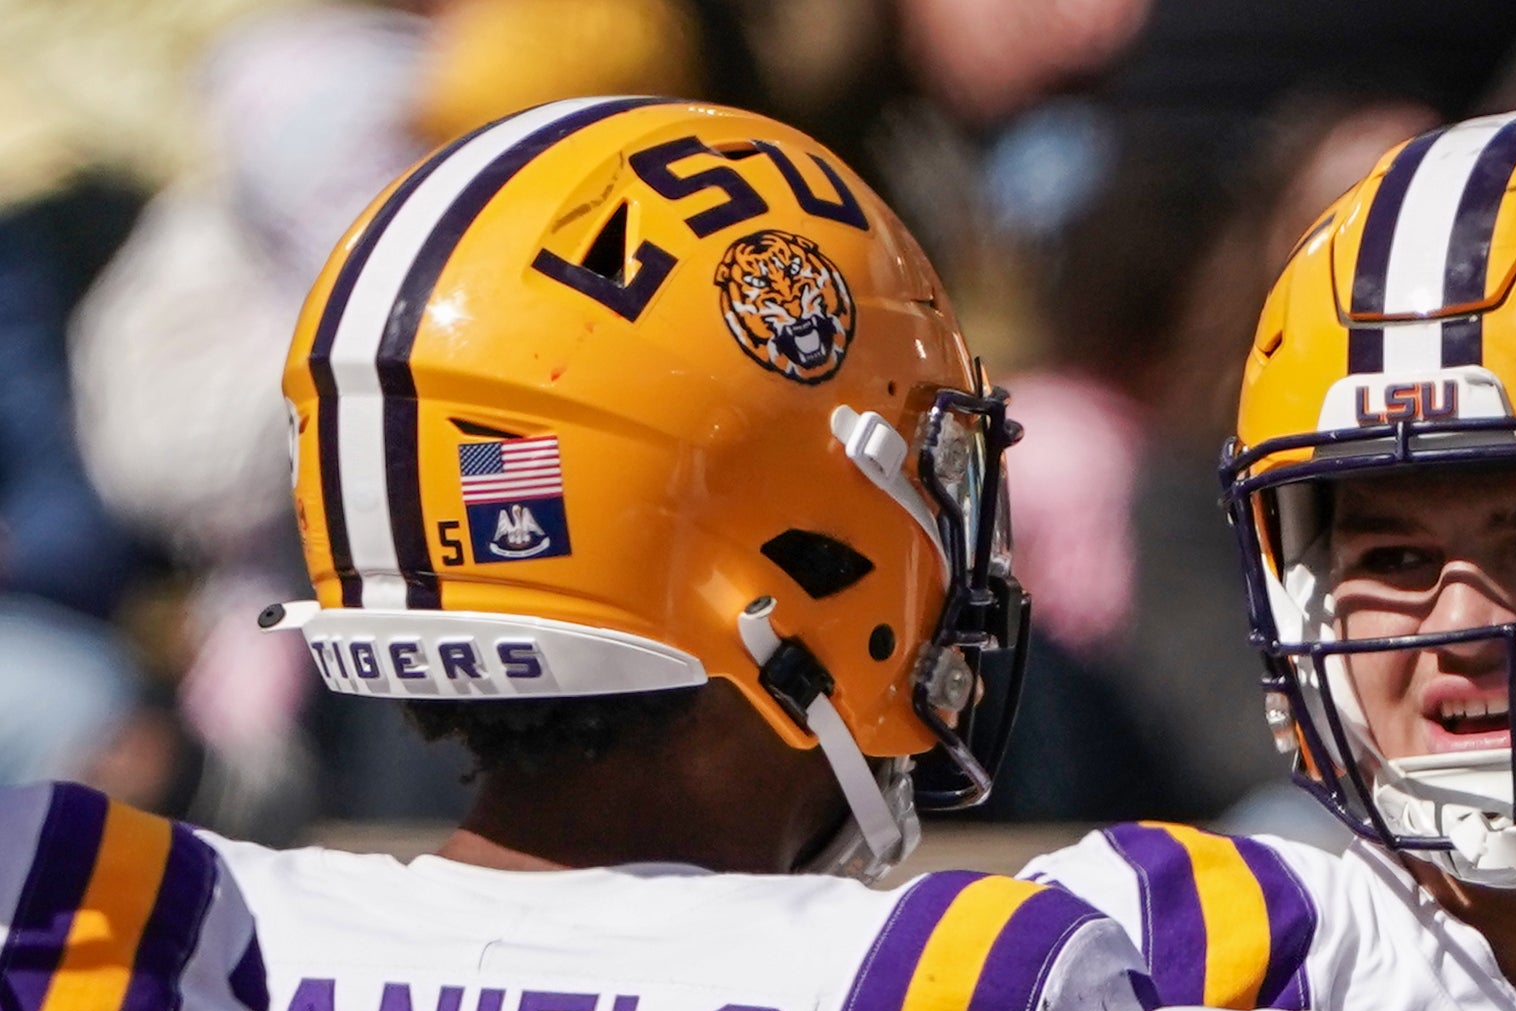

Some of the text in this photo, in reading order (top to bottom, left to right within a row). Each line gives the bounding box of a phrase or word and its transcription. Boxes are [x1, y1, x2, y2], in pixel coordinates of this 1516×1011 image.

[531, 135, 870, 324] LSU
[1356, 379, 1459, 427] LSU
[437, 521, 464, 566] 5
[311, 641, 543, 679] TIGERS
